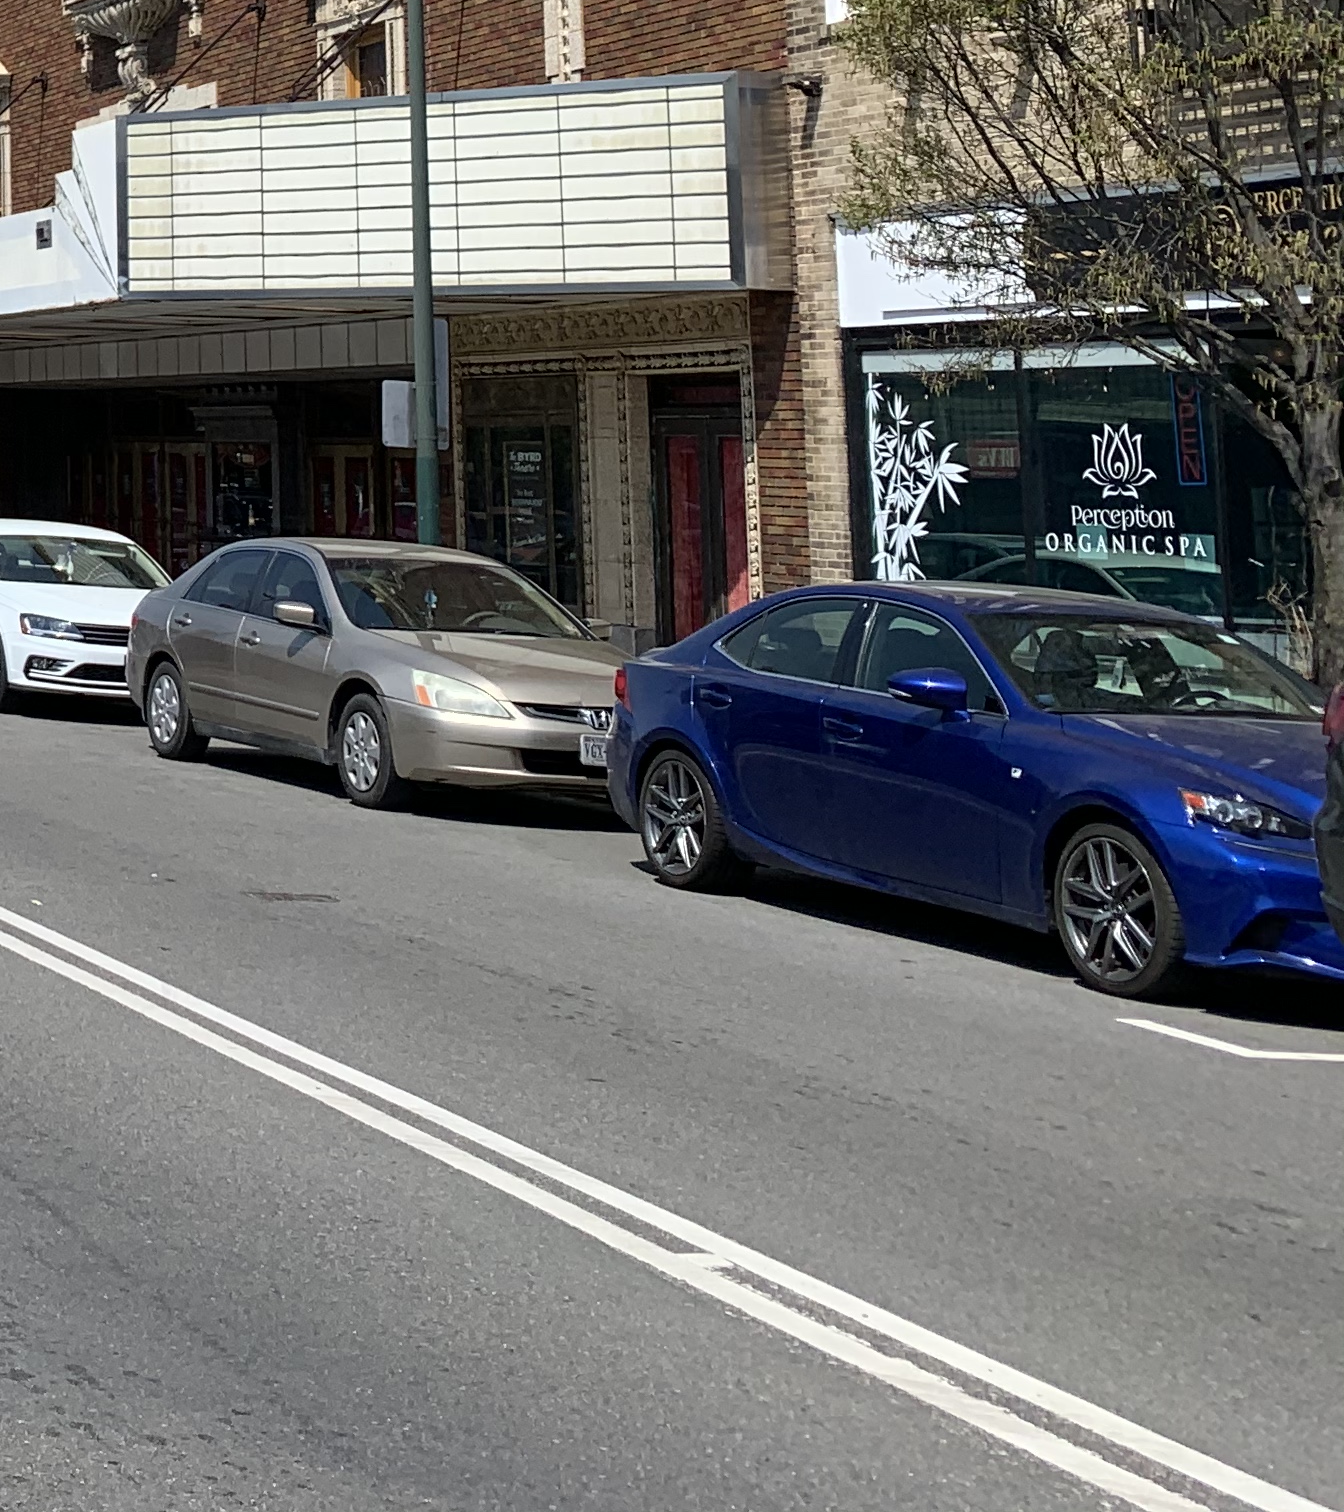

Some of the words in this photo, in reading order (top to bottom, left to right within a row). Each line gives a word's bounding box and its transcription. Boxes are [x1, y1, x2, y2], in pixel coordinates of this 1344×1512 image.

[517, 451, 542, 462] BYRD
[1071, 504, 1175, 531] Perception
[1045, 532, 1156, 554] ORGANIC
[1165, 535, 1208, 557] SPA
[585, 743, 607, 758] VGX-
